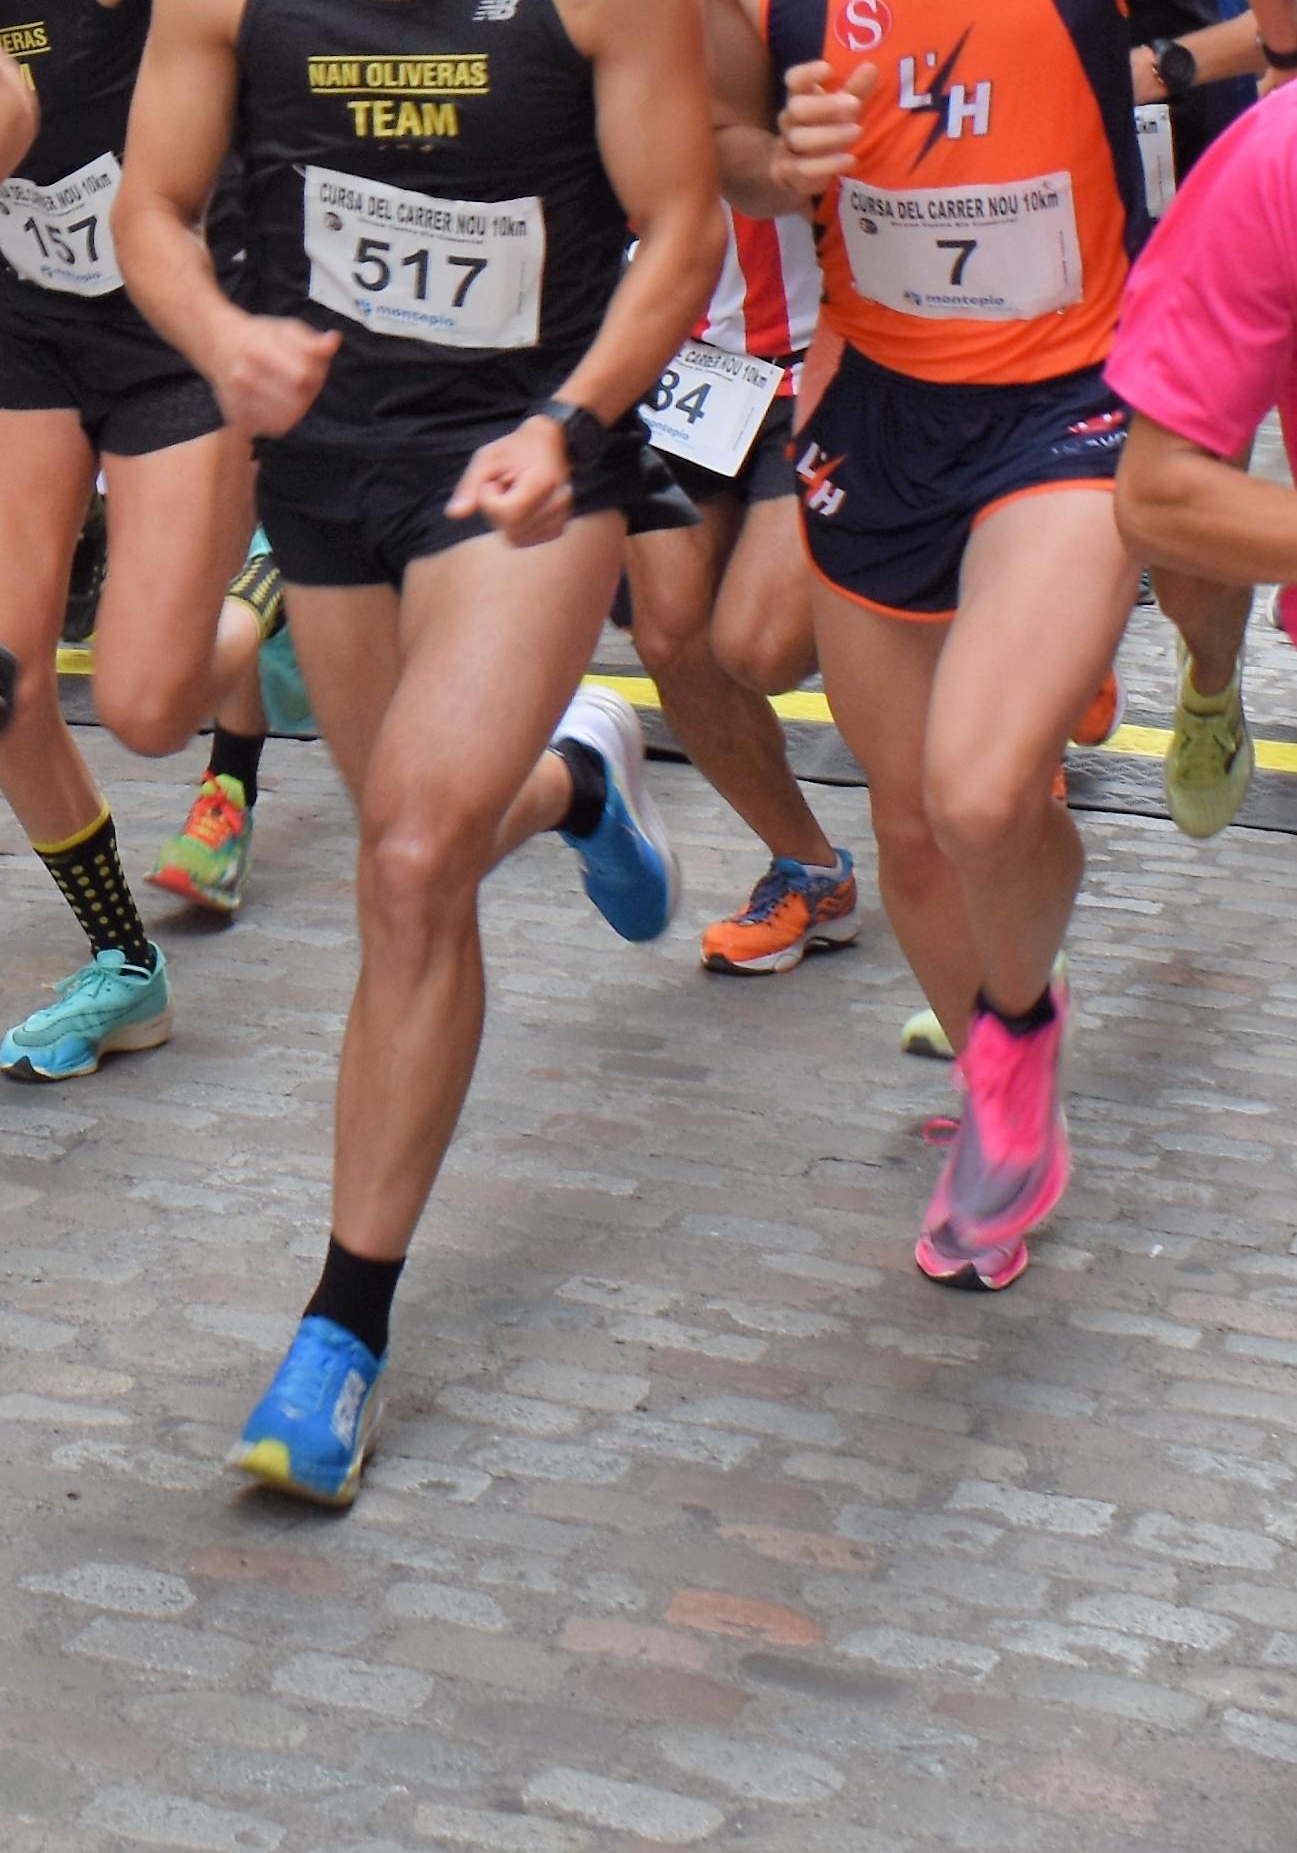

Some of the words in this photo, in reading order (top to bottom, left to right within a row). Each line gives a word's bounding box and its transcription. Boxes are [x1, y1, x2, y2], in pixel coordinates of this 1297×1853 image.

[308, 63, 360, 87] NAN
[366, 61, 488, 87] OLIVERAS
[347, 100, 460, 138] TEAM
[320, 182, 363, 211] CURSA
[367, 196, 392, 220] DEL
[397, 203, 451, 233] CARRER
[457, 214, 486, 236] NOU
[492, 215, 526, 237] 10km
[851, 191, 894, 218] CURSA
[897, 201, 924, 220] DEL
[928, 197, 984, 220] CARRER
[988, 196, 1018, 216] NOU
[1023, 190, 1059, 212] 10km
[24, 215, 99, 265] 157
[353, 237, 488, 308] 517
[936, 239, 977, 286] 7
[376, 304, 454, 327] montepio
[925, 293, 1005, 306] montepio
[722, 357, 743, 376] NOU
